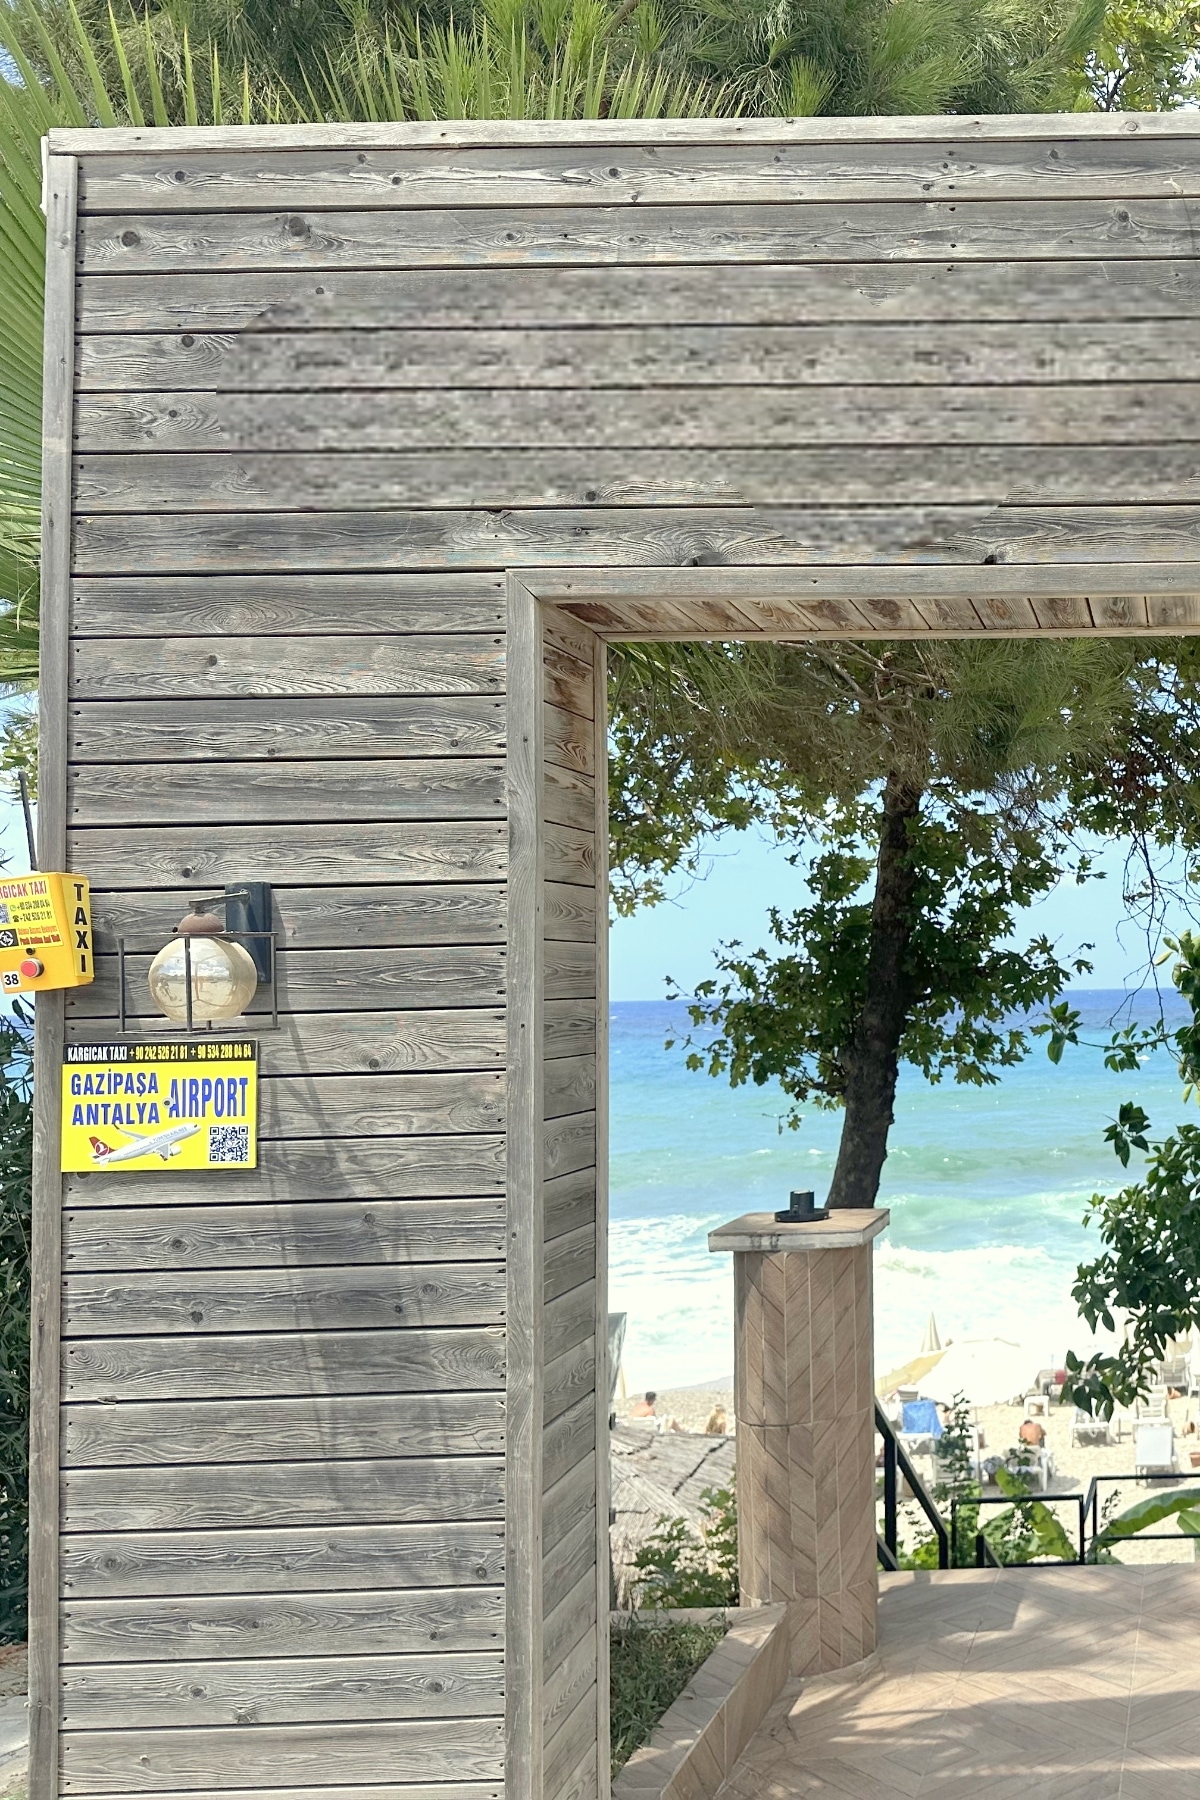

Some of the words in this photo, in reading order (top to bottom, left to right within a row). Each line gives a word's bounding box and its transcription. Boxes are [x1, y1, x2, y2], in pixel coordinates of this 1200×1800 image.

[29, 880, 47, 895] TAXI
[73, 883, 89, 973] TAXI
[4, 974, 19, 985] 38
[67, 1046, 108, 1061] KARGICAK
[109, 1046, 128, 1060] TAXI
[144, 1046, 156, 1060] 242
[158, 1045, 170, 1060] 526
[170, 1045, 178, 1059] 21
[180, 1045, 188, 1059] 81
[207, 1044, 220, 1058] 534
[220, 1044, 232, 1058] 288
[234, 1044, 242, 1058] 04
[244, 1043, 252, 1058] 64
[71, 1068, 159, 1097] GAZİPAŞA
[168, 1077, 248, 1118] AIRPORT
[72, 1102, 160, 1125] ANTALYA
